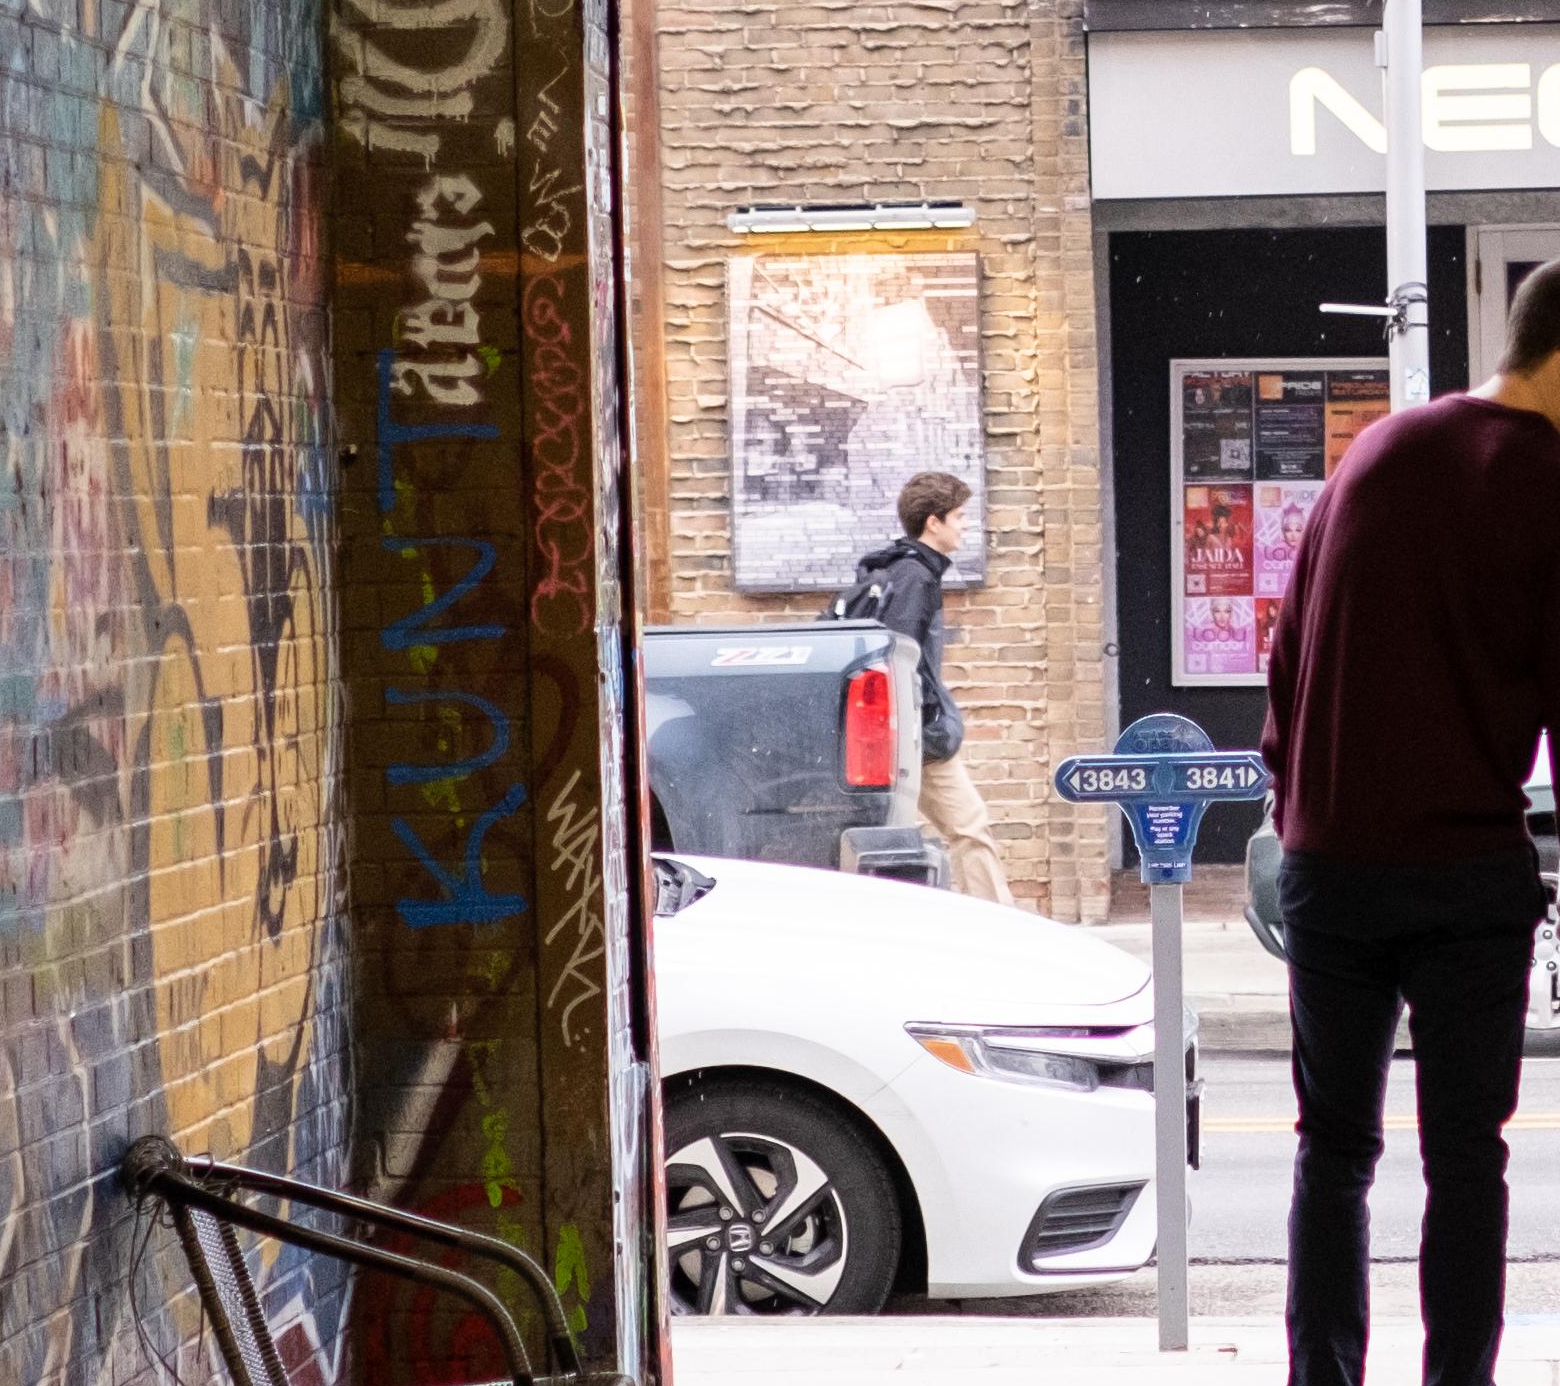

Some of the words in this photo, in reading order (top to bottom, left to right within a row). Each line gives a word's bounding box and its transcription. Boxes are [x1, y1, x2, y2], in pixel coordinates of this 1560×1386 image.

[1190, 547, 1244, 563] JAIDA
[1083, 769, 1146, 792] 3843
[1186, 766, 1246, 790] 3841
